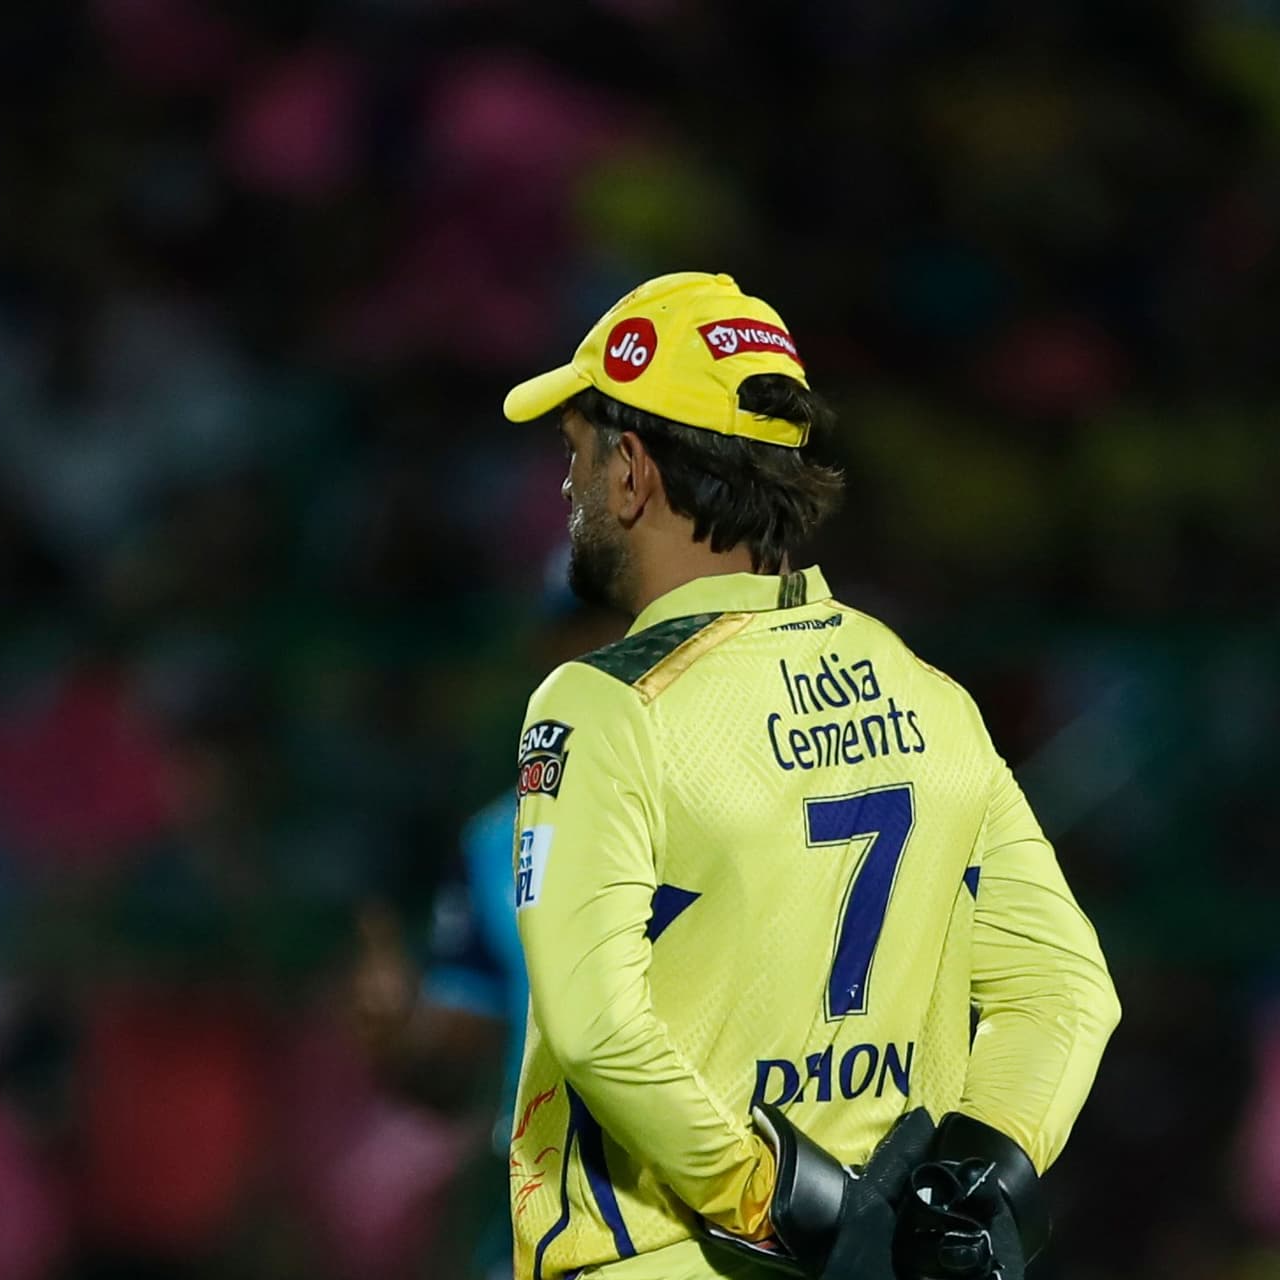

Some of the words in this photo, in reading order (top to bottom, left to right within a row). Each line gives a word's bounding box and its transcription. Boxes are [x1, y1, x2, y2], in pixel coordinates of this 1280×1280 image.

[609, 332, 648, 367] Jio
[780, 652, 881, 716] India
[767, 697, 926, 771] Cements
[803, 781, 916, 1023] 7
